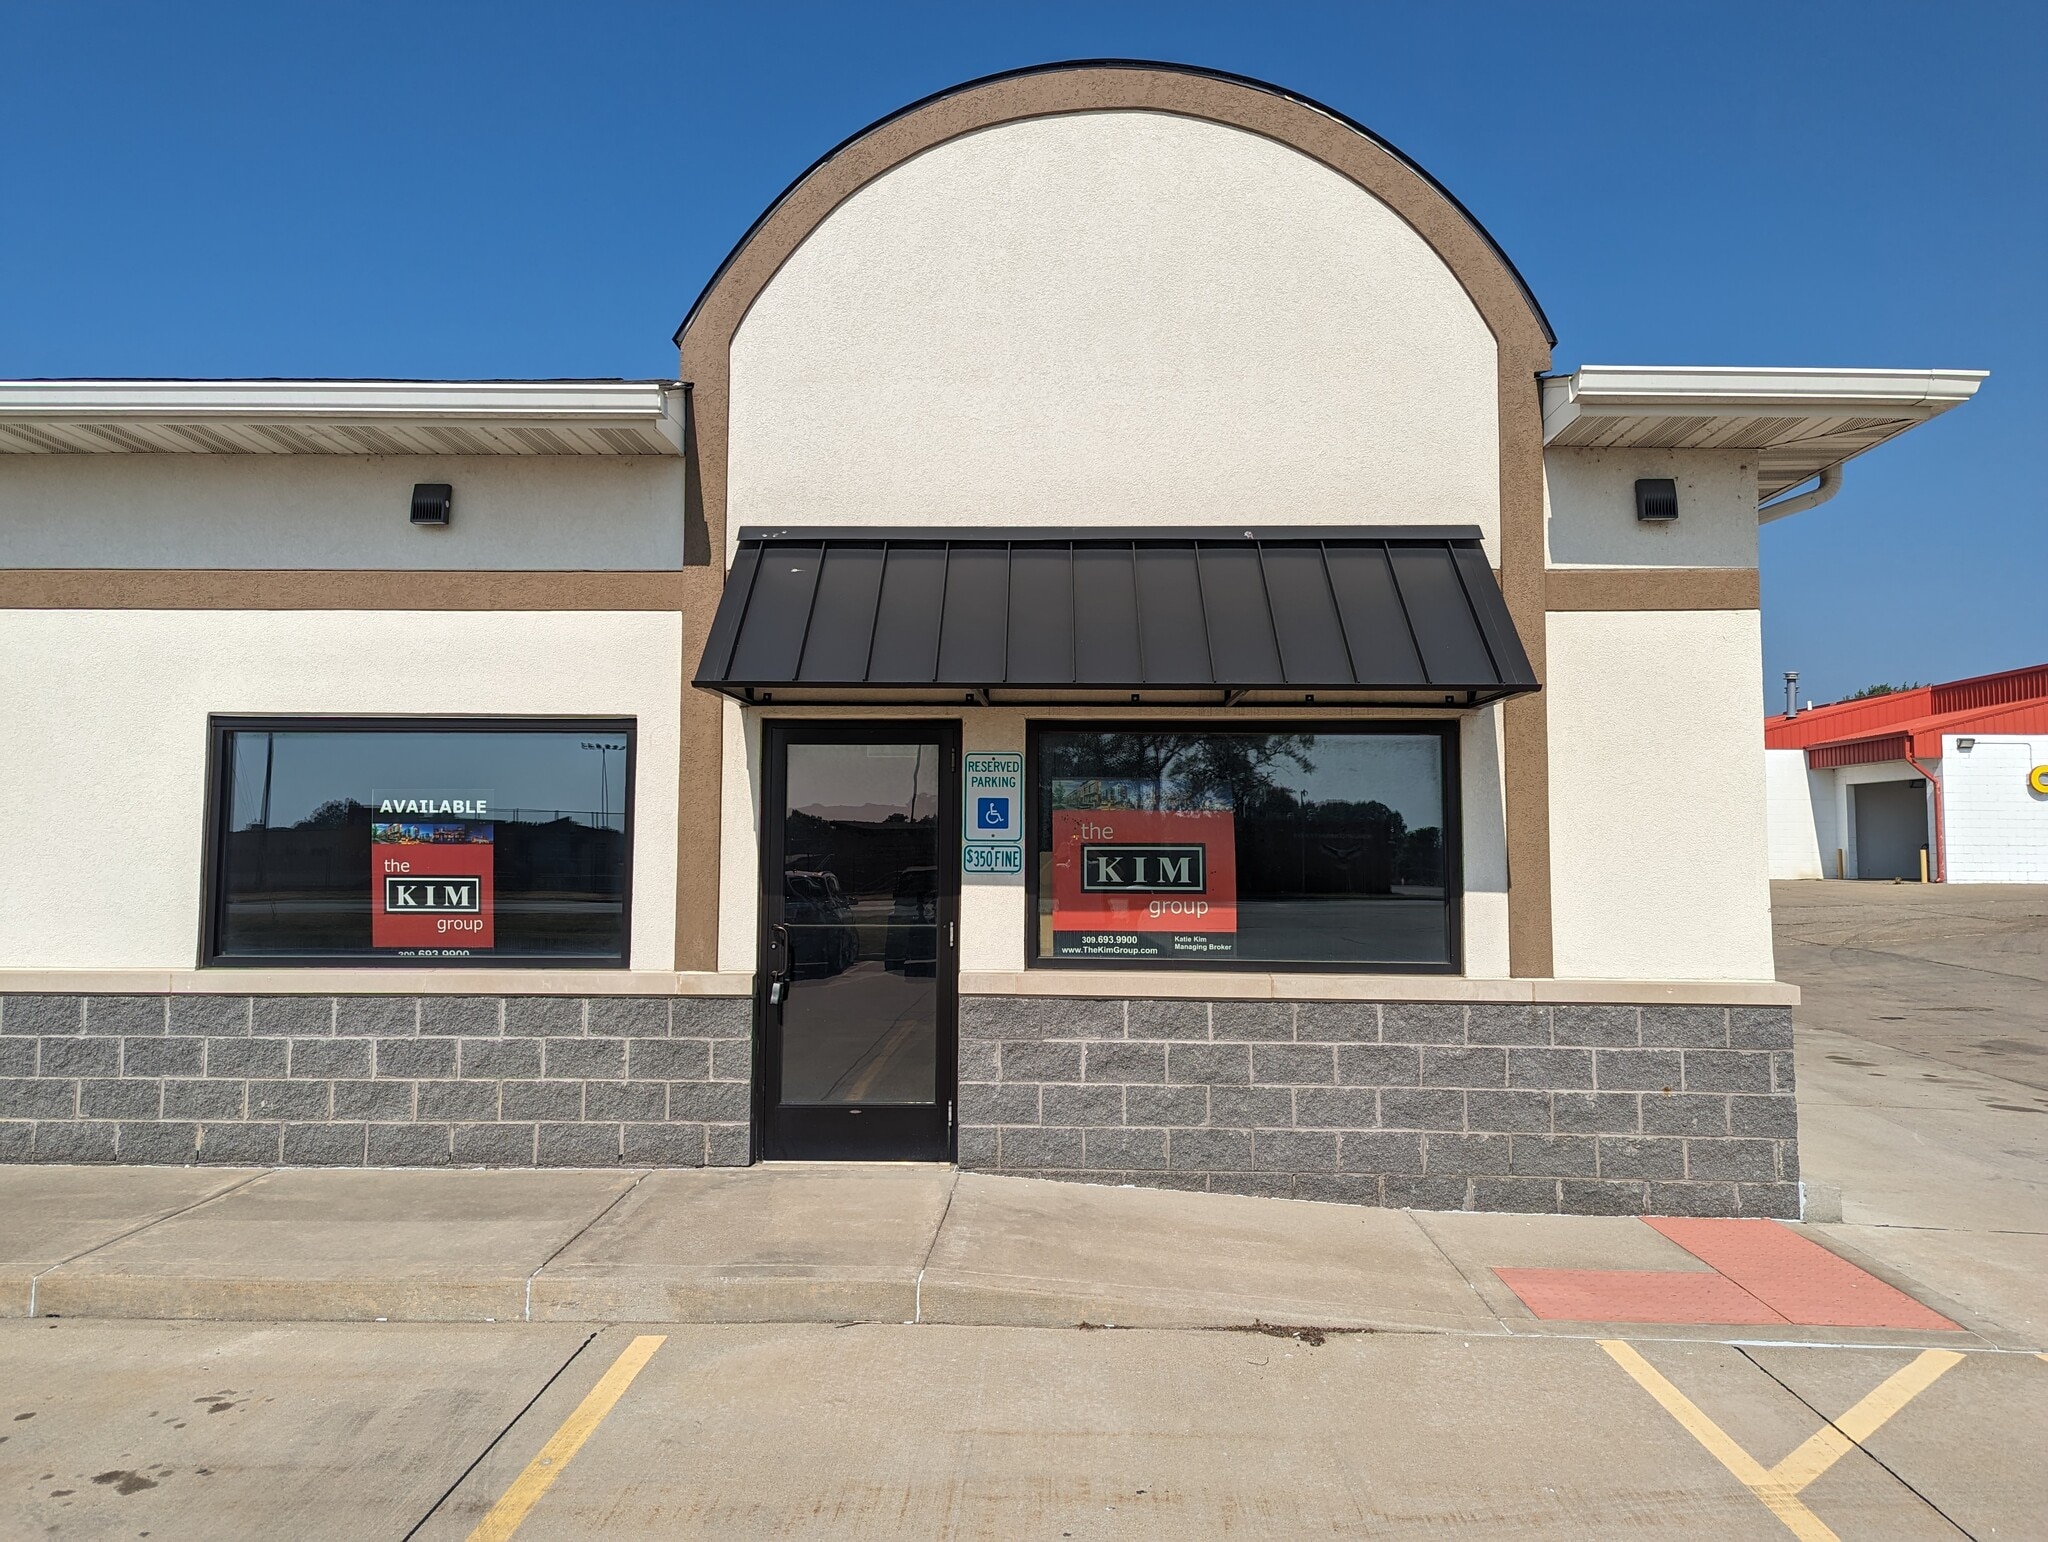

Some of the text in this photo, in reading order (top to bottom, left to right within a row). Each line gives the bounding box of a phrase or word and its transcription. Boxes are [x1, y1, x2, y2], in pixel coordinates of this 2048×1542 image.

[968, 761, 1020, 773] RESERVED
[971, 776, 1017, 788] PARKING
[379, 799, 487, 814] AVAILABLE
[1080, 822, 1114, 840] the
[384, 858, 411, 873] the
[966, 848, 1019, 868] $350 FINE
[1096, 856, 1193, 883] KIM
[396, 885, 471, 906] KIM
[1149, 900, 1209, 918] group
[436, 918, 483, 933] group
[1081, 935, 1138, 944] 309.693.9900
[1174, 935, 1192, 943] Katie
[1061, 946, 1158, 955] www.TheKimGroup.com
[1174, 943, 1232, 951] Managing Broker
